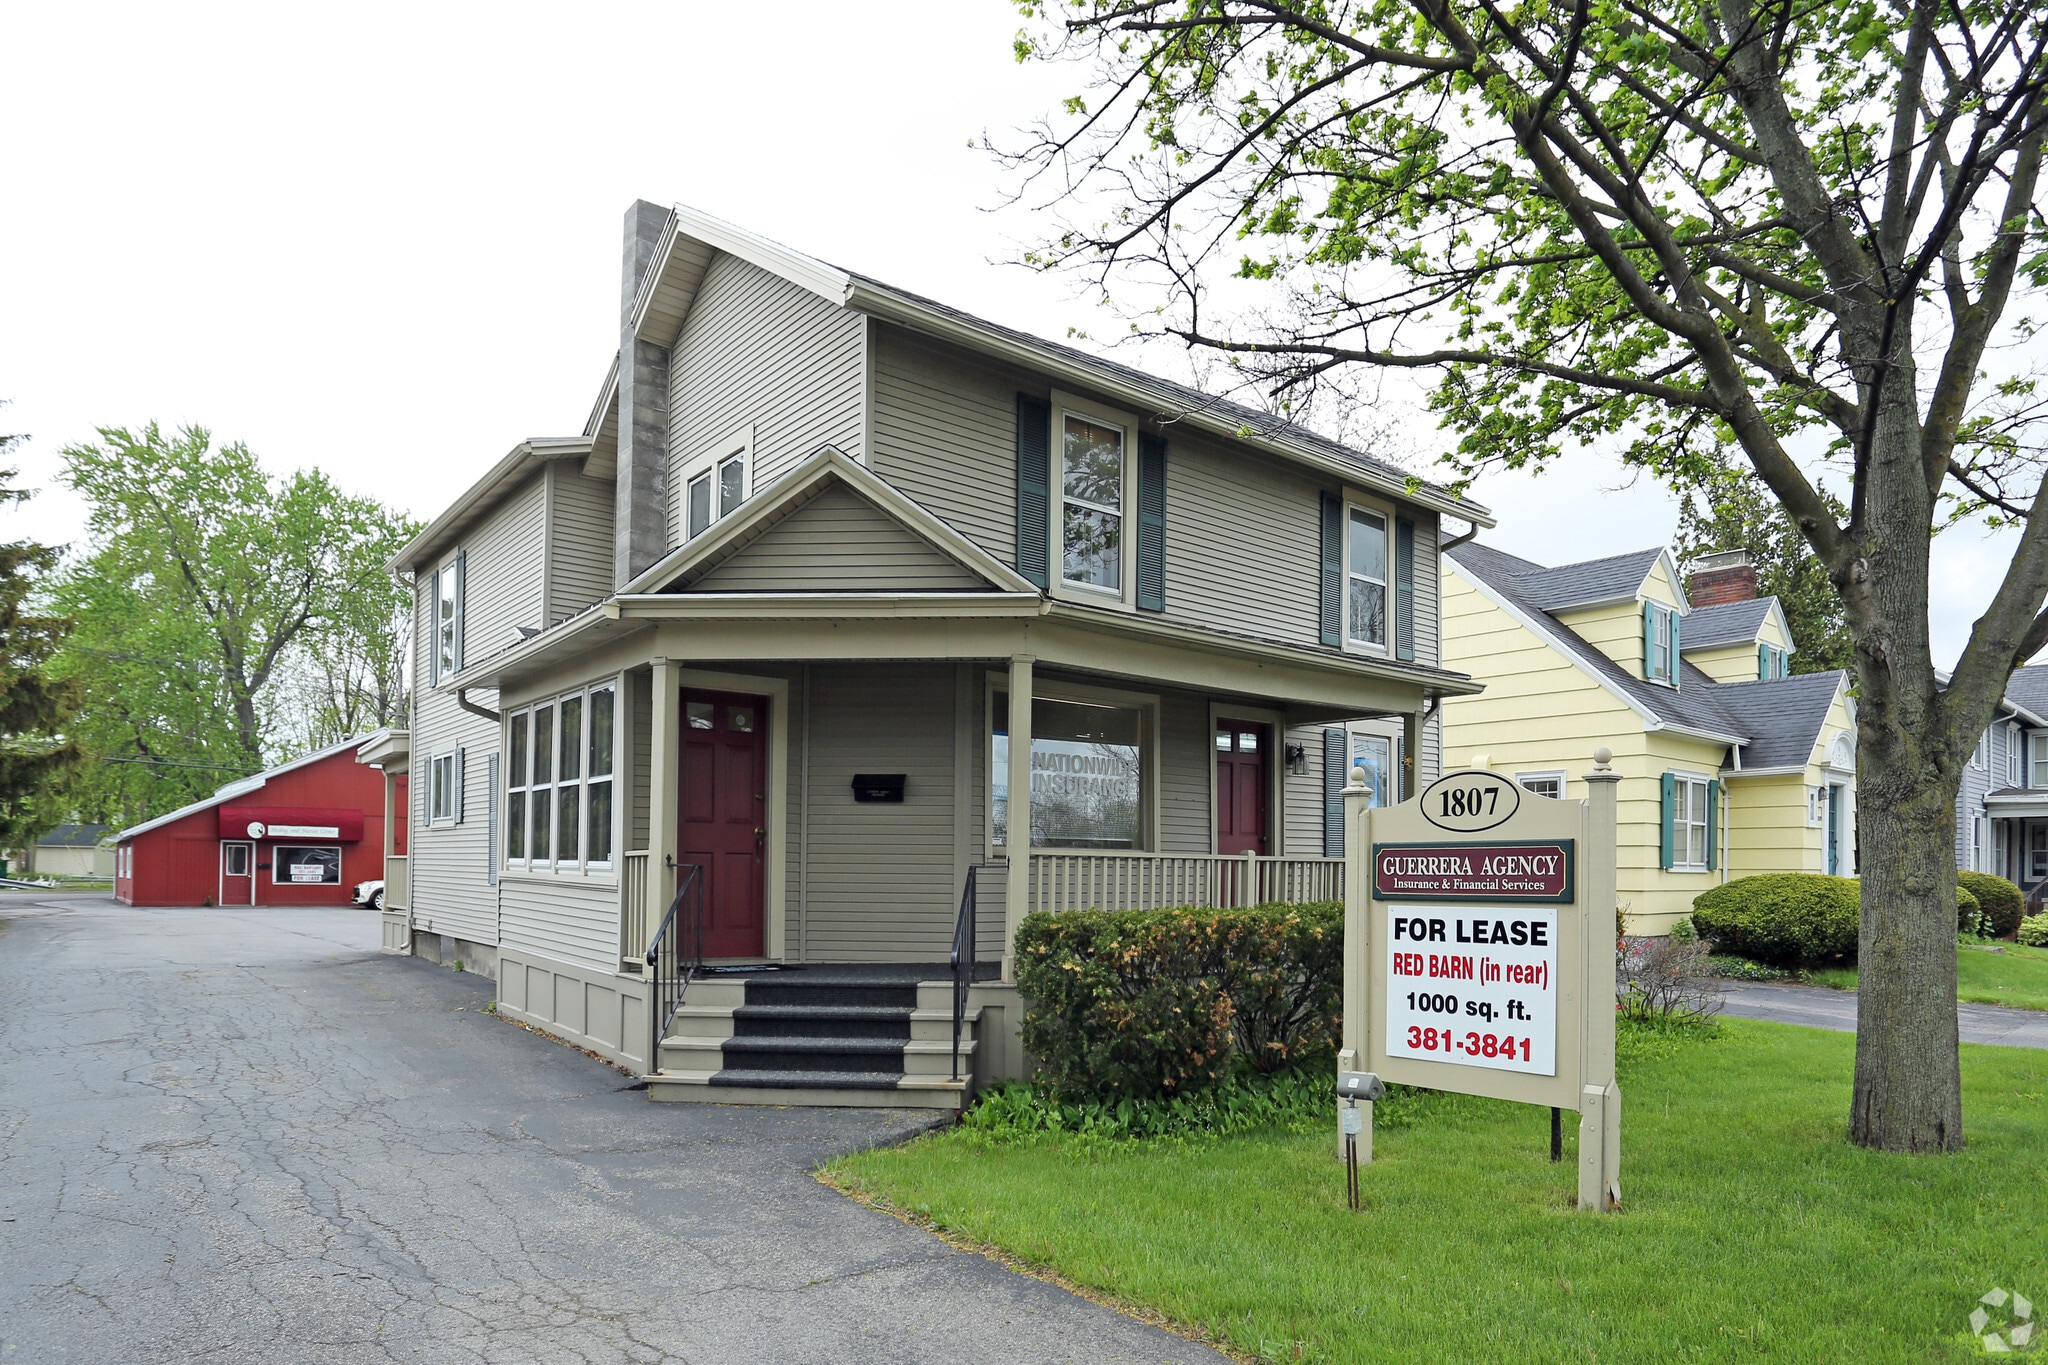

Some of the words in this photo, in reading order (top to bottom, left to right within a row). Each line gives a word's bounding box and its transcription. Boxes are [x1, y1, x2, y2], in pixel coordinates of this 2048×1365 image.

[1032, 751, 1137, 777] NATIONWIDE
[1032, 773, 1137, 798] INSURANCE
[1439, 787, 1499, 817] 1807
[1382, 856, 1473, 876] GUERRERA
[1480, 855, 1559, 876] AGENCY
[1394, 877, 1439, 889] Insurance
[1441, 879, 1451, 890] &
[1453, 878, 1499, 890] Financial
[1501, 878, 1545, 891] Services
[1394, 917, 1446, 942] FOR
[1456, 919, 1548, 947] LEASE
[1393, 952, 1424, 977] RED
[1429, 954, 1473, 980] BARN
[1479, 957, 1501, 986] (in
[1506, 960, 1548, 991] rear)
[1407, 992, 1458, 1014] 1000
[1465, 1000, 1499, 1023] sq.
[1506, 999, 1532, 1021] ft.
[1407, 1025, 1531, 1062] 381-3841
